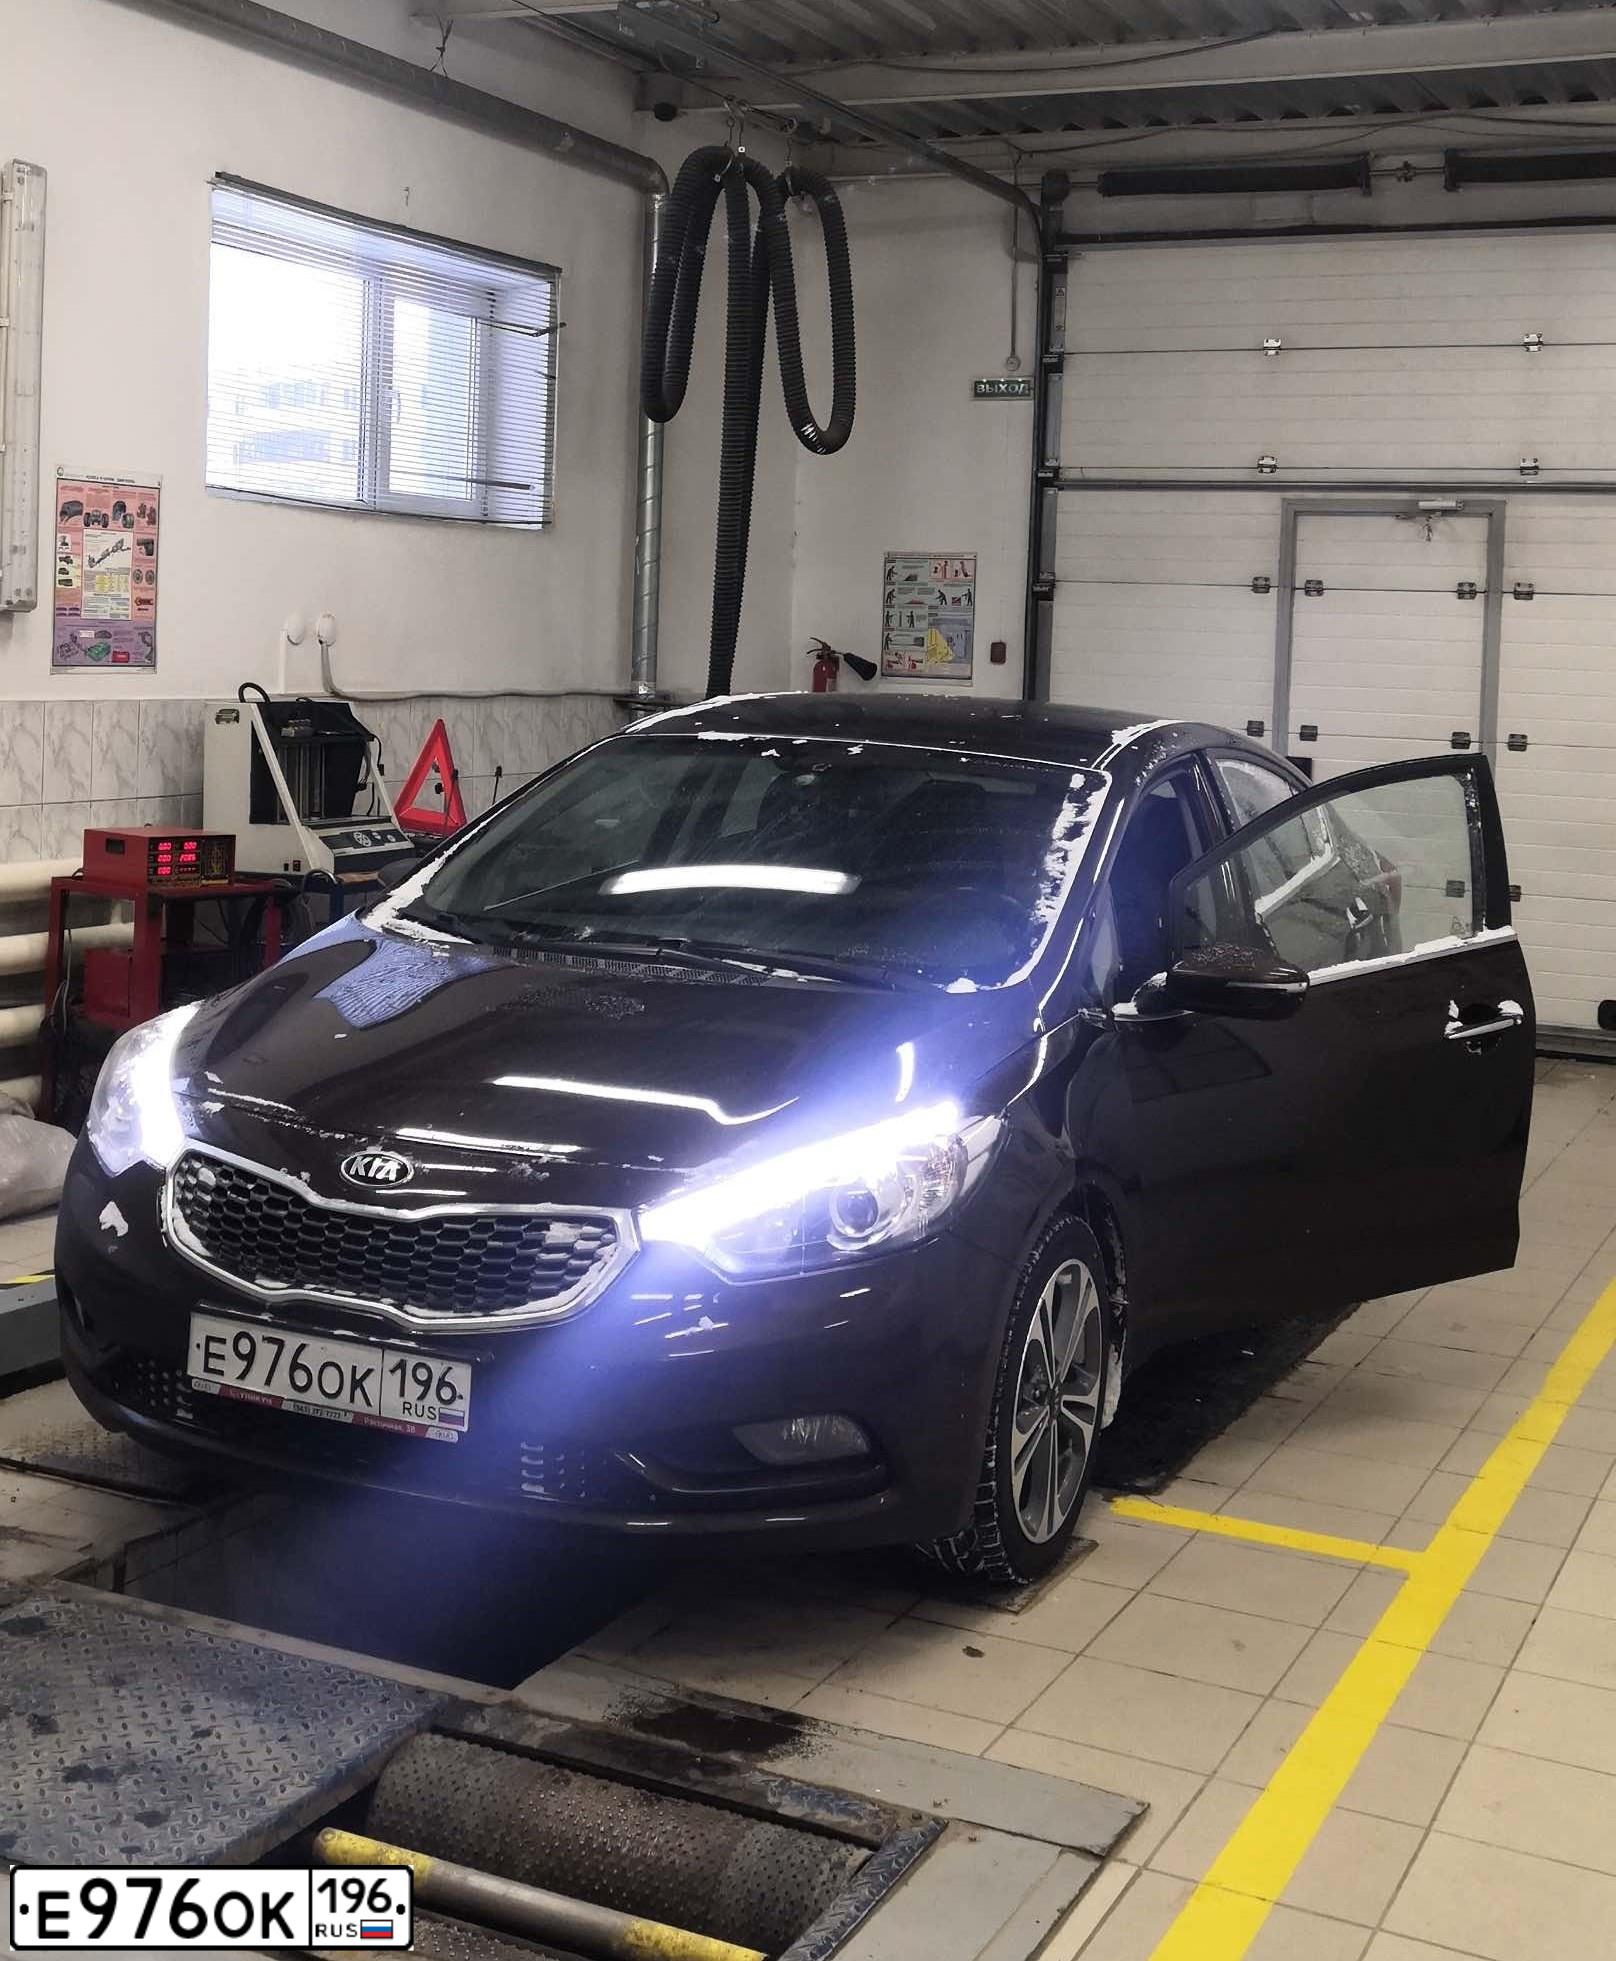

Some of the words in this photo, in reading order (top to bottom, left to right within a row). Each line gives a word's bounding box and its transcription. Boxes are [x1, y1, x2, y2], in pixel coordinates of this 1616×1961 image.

[349, 1155, 401, 1182] KIA
[389, 1358, 458, 1405] 196
[402, 1401, 437, 1420] RUS
